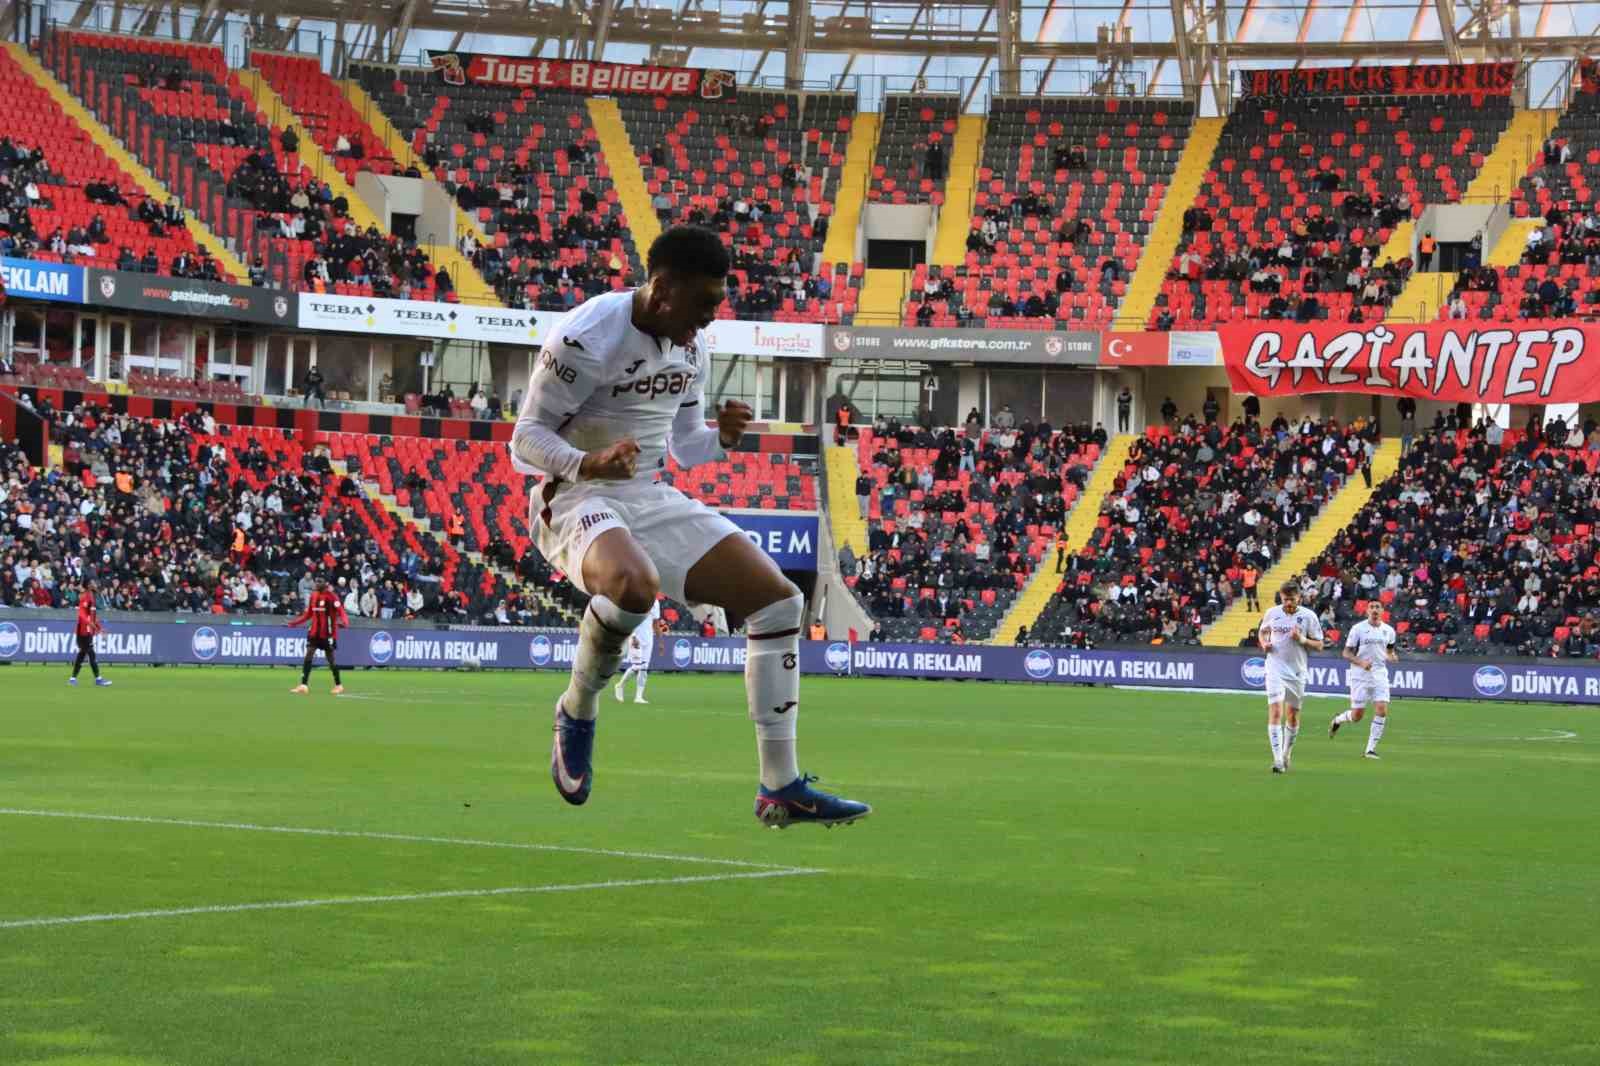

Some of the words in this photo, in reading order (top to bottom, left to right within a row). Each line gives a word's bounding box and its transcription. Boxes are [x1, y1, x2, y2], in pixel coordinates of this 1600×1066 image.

[475, 57, 554, 84] Just
[570, 63, 691, 91] Believe
[1251, 67, 1386, 96] ATTACK
[1405, 65, 1465, 88] FOR
[310, 303, 363, 315] TEBA
[393, 309, 446, 321] TEBA
[475, 316, 527, 328] TEBA
[893, 337, 1031, 350] www.gfkstore.com.tr
[221, 627, 271, 657] DÜNYA
[395, 636, 441, 660] DÜNYA
[444, 640, 498, 661] REKLAM
[693, 642, 730, 665] DÜNYA
[854, 648, 909, 670] DÜNYA
[913, 653, 982, 672] REKLAM
[1057, 654, 1116, 678] DÜNYA
[1121, 659, 1194, 680] REKLAM
[1304, 667, 1340, 686] NYA
[1511, 670, 1579, 695] DÜNYA
